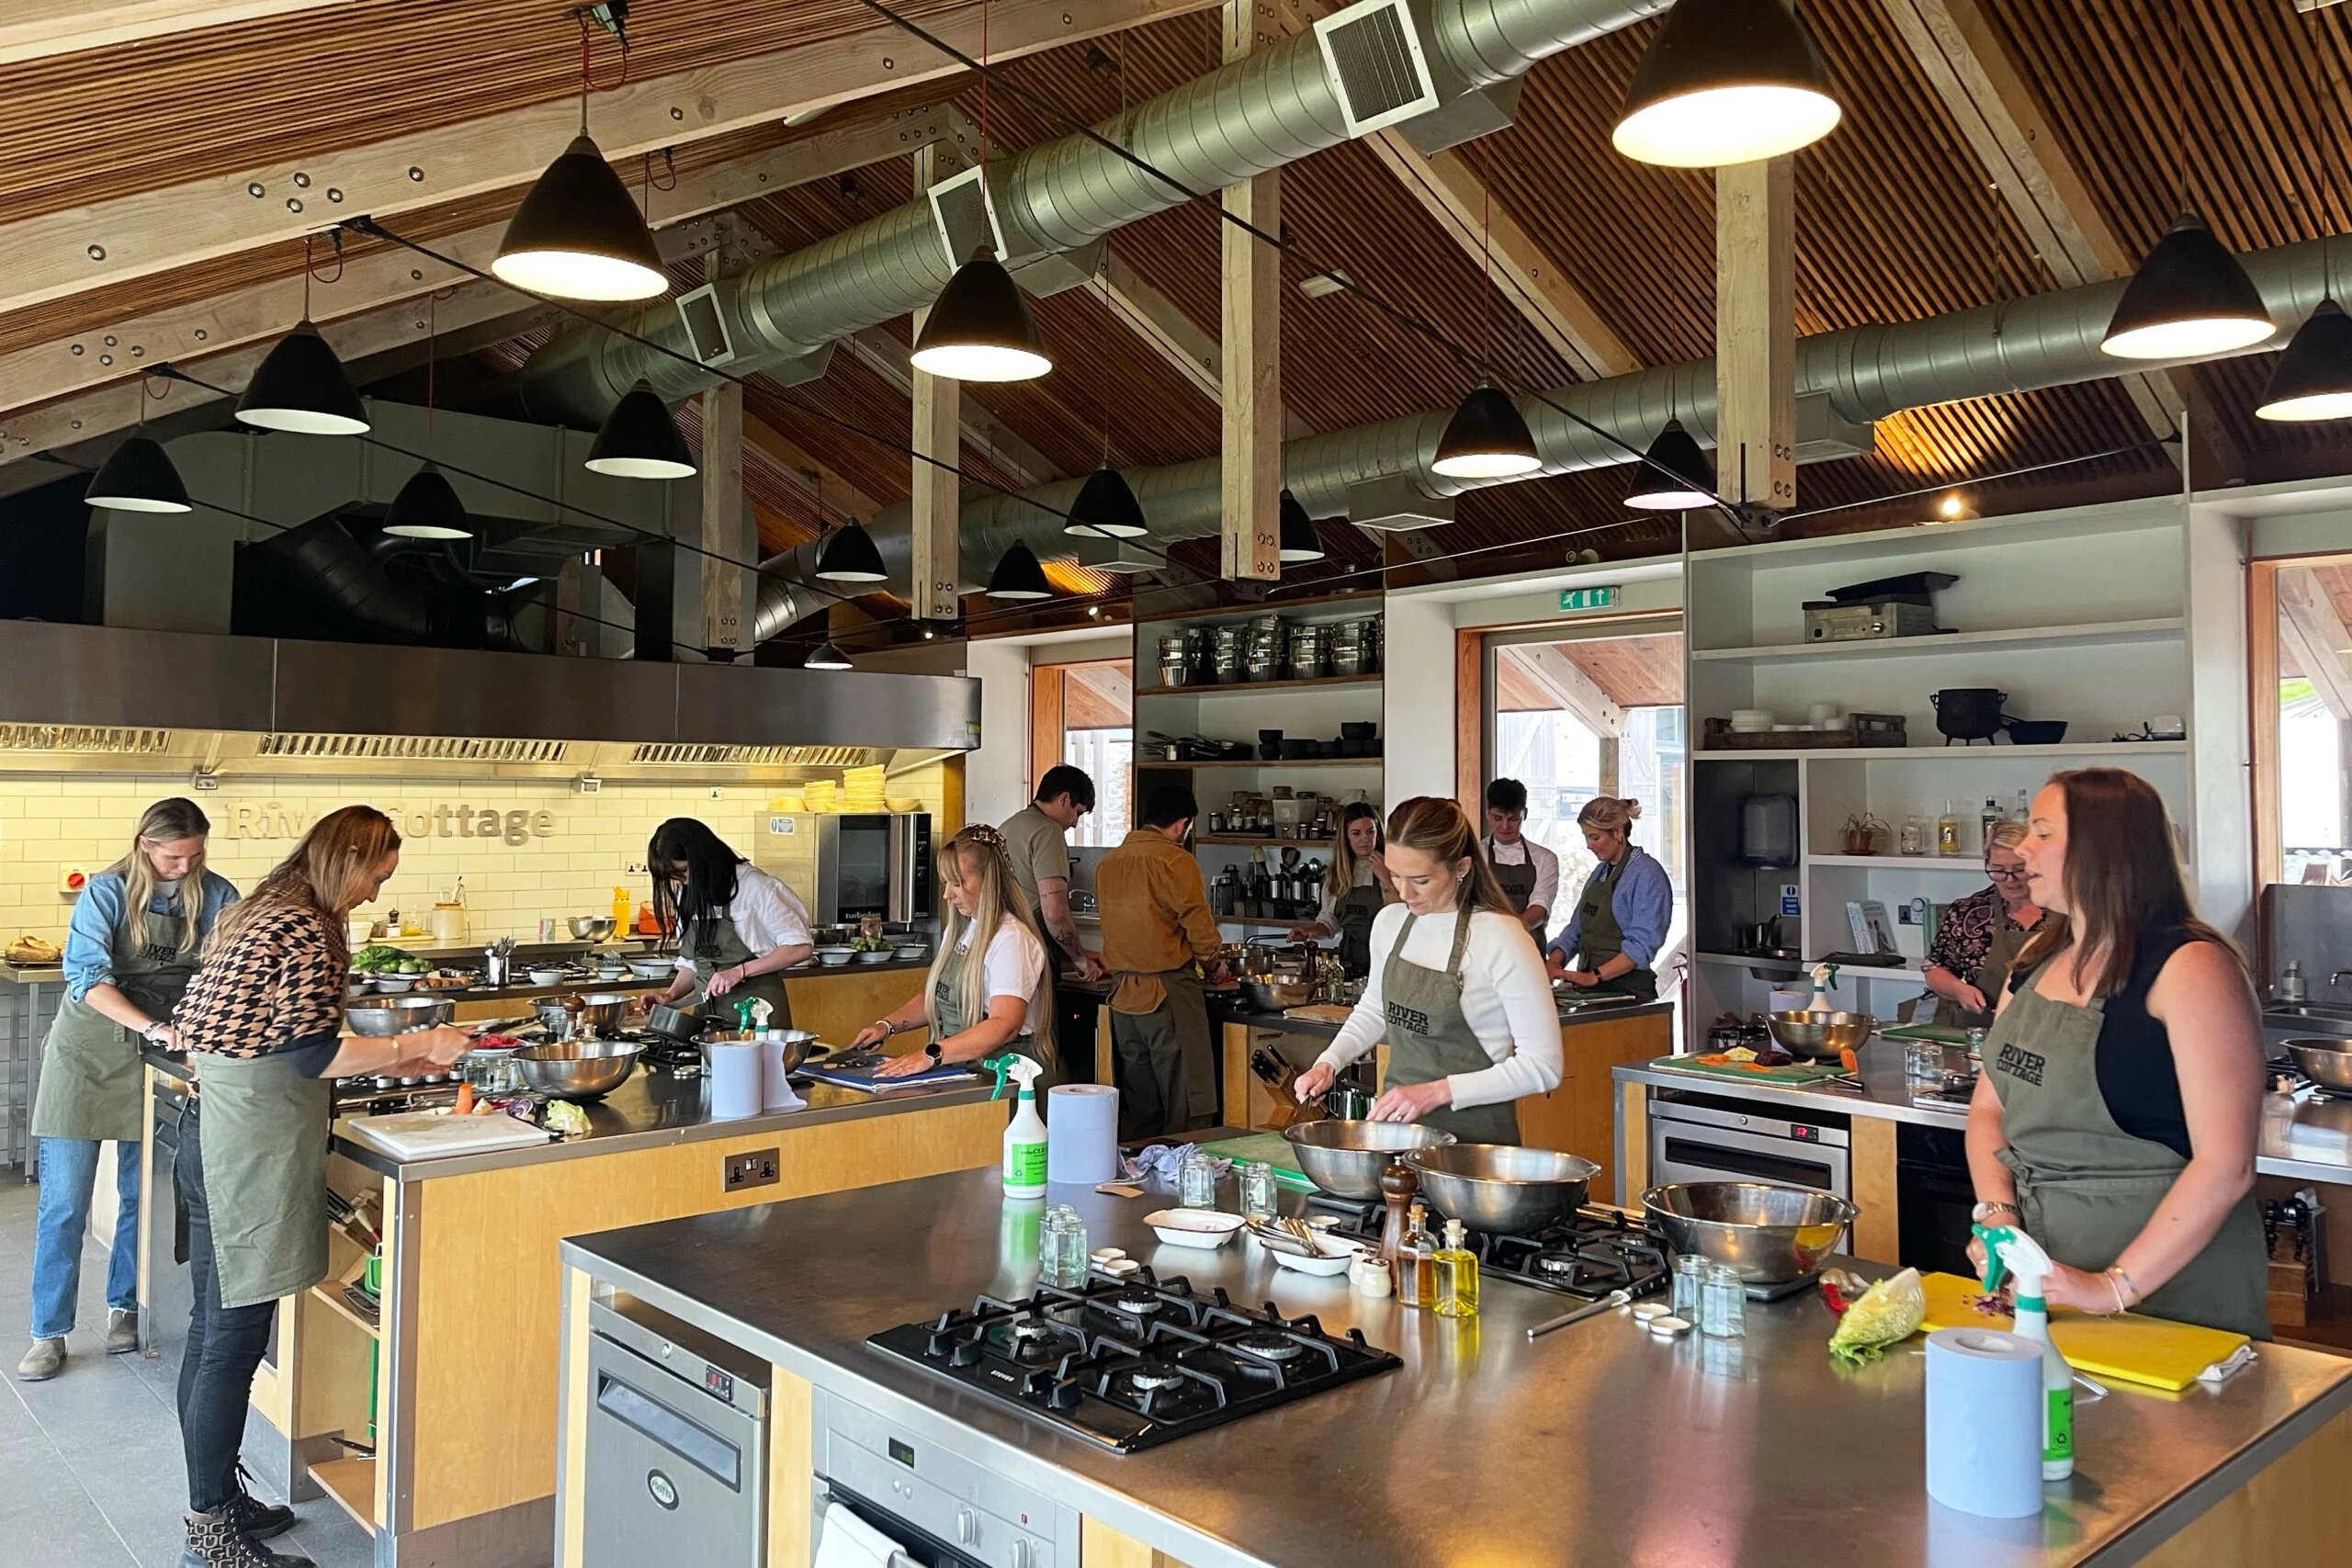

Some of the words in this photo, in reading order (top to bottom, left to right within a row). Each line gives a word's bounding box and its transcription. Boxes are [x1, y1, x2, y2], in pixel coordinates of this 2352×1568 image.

[226, 802, 323, 840] Riv
[143, 943, 176, 956] IVER
[1388, 1001, 1429, 1025] RIVER
[1388, 1014, 1429, 1035] COTTAGE
[1999, 1043, 2045, 1074] RIVER
[1997, 1058, 2042, 1087] COTTAGE
